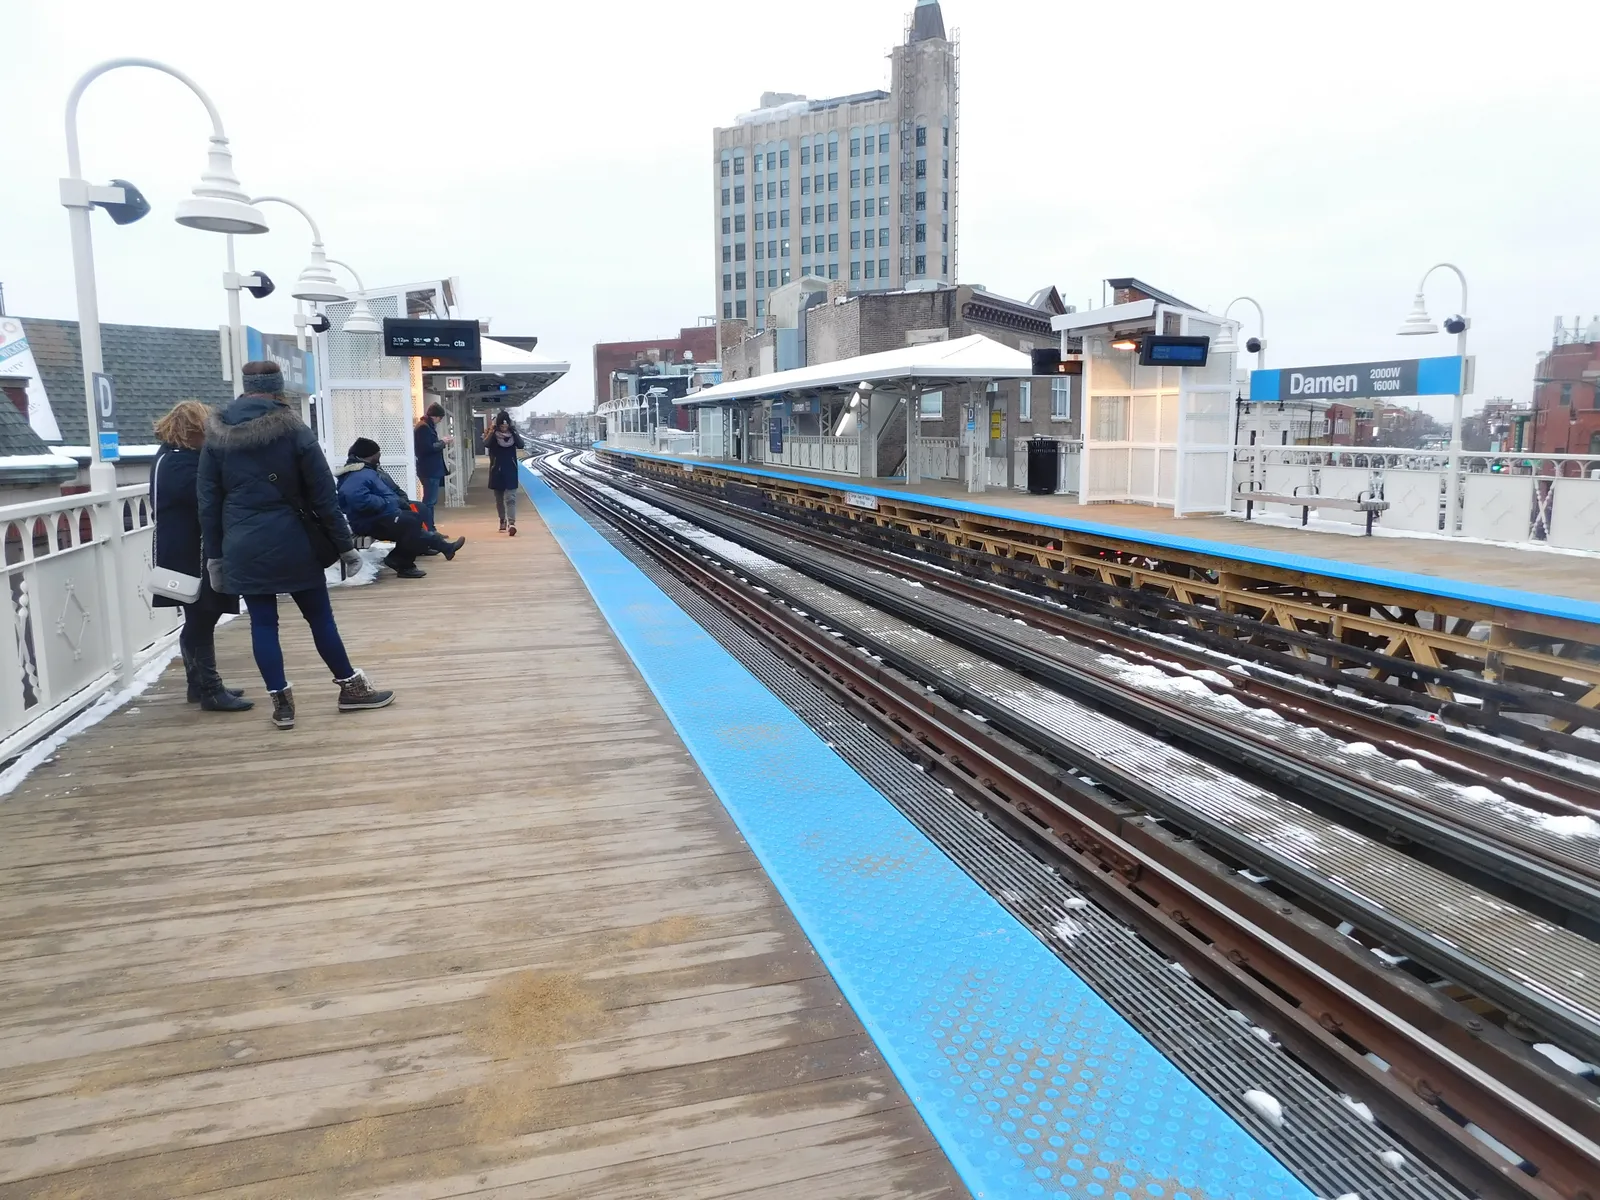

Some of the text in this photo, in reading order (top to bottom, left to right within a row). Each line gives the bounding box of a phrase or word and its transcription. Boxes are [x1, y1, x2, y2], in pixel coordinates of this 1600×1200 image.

[1369, 367, 1402, 379] 2000W
[448, 378, 461, 388] EXIT
[1290, 373, 1358, 395] Damen
[1372, 380, 1400, 392] 1600N
[98, 376, 112, 417] D
[968, 408, 974, 419] D
